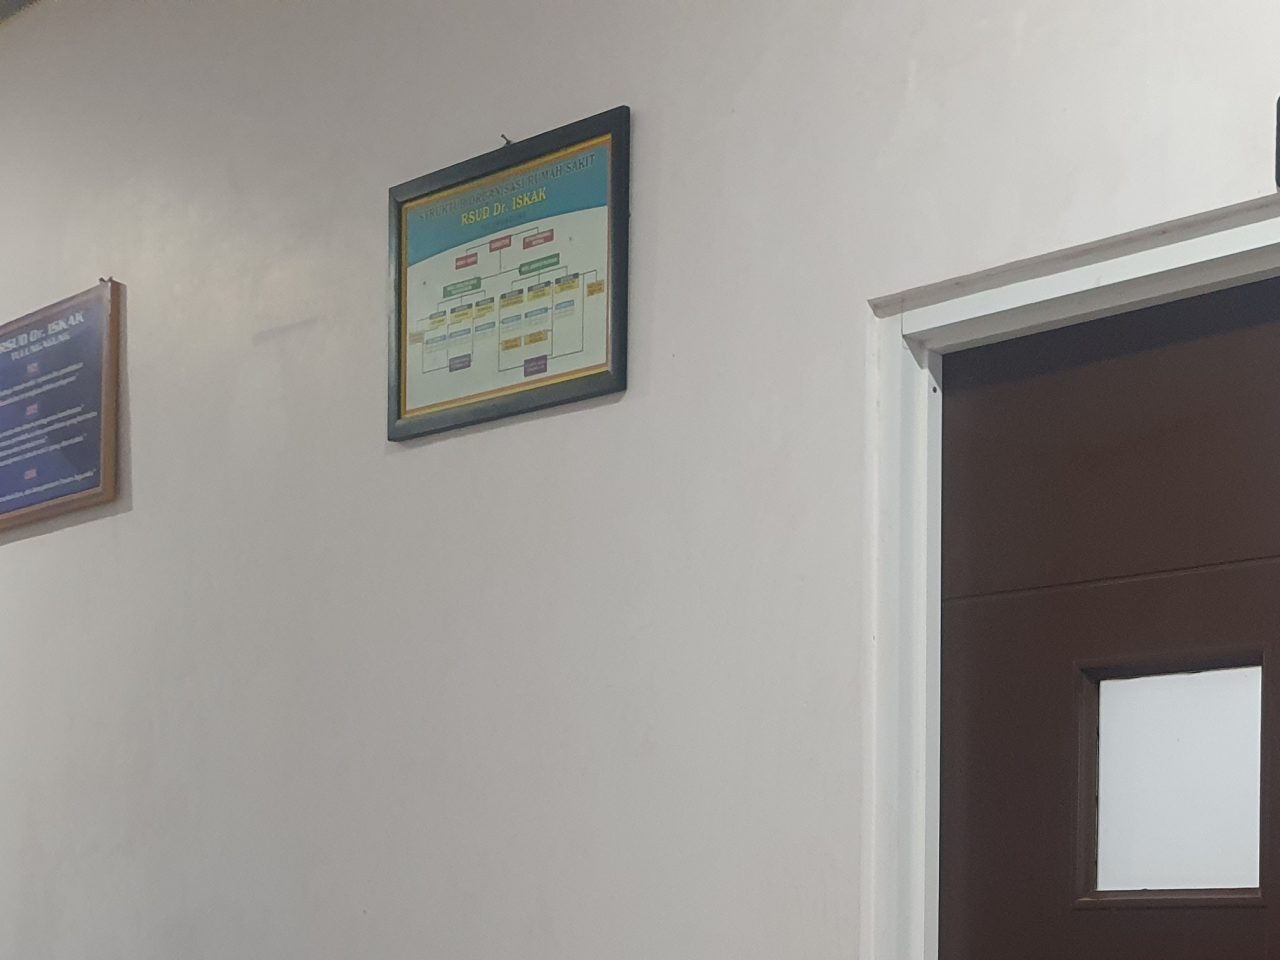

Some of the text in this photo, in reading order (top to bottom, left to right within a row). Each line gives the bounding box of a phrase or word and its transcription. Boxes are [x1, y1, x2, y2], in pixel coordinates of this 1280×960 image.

[566, 153, 595, 173] SAKIT
[461, 206, 490, 225] RSUD
[512, 187, 546, 210] ISKAK
